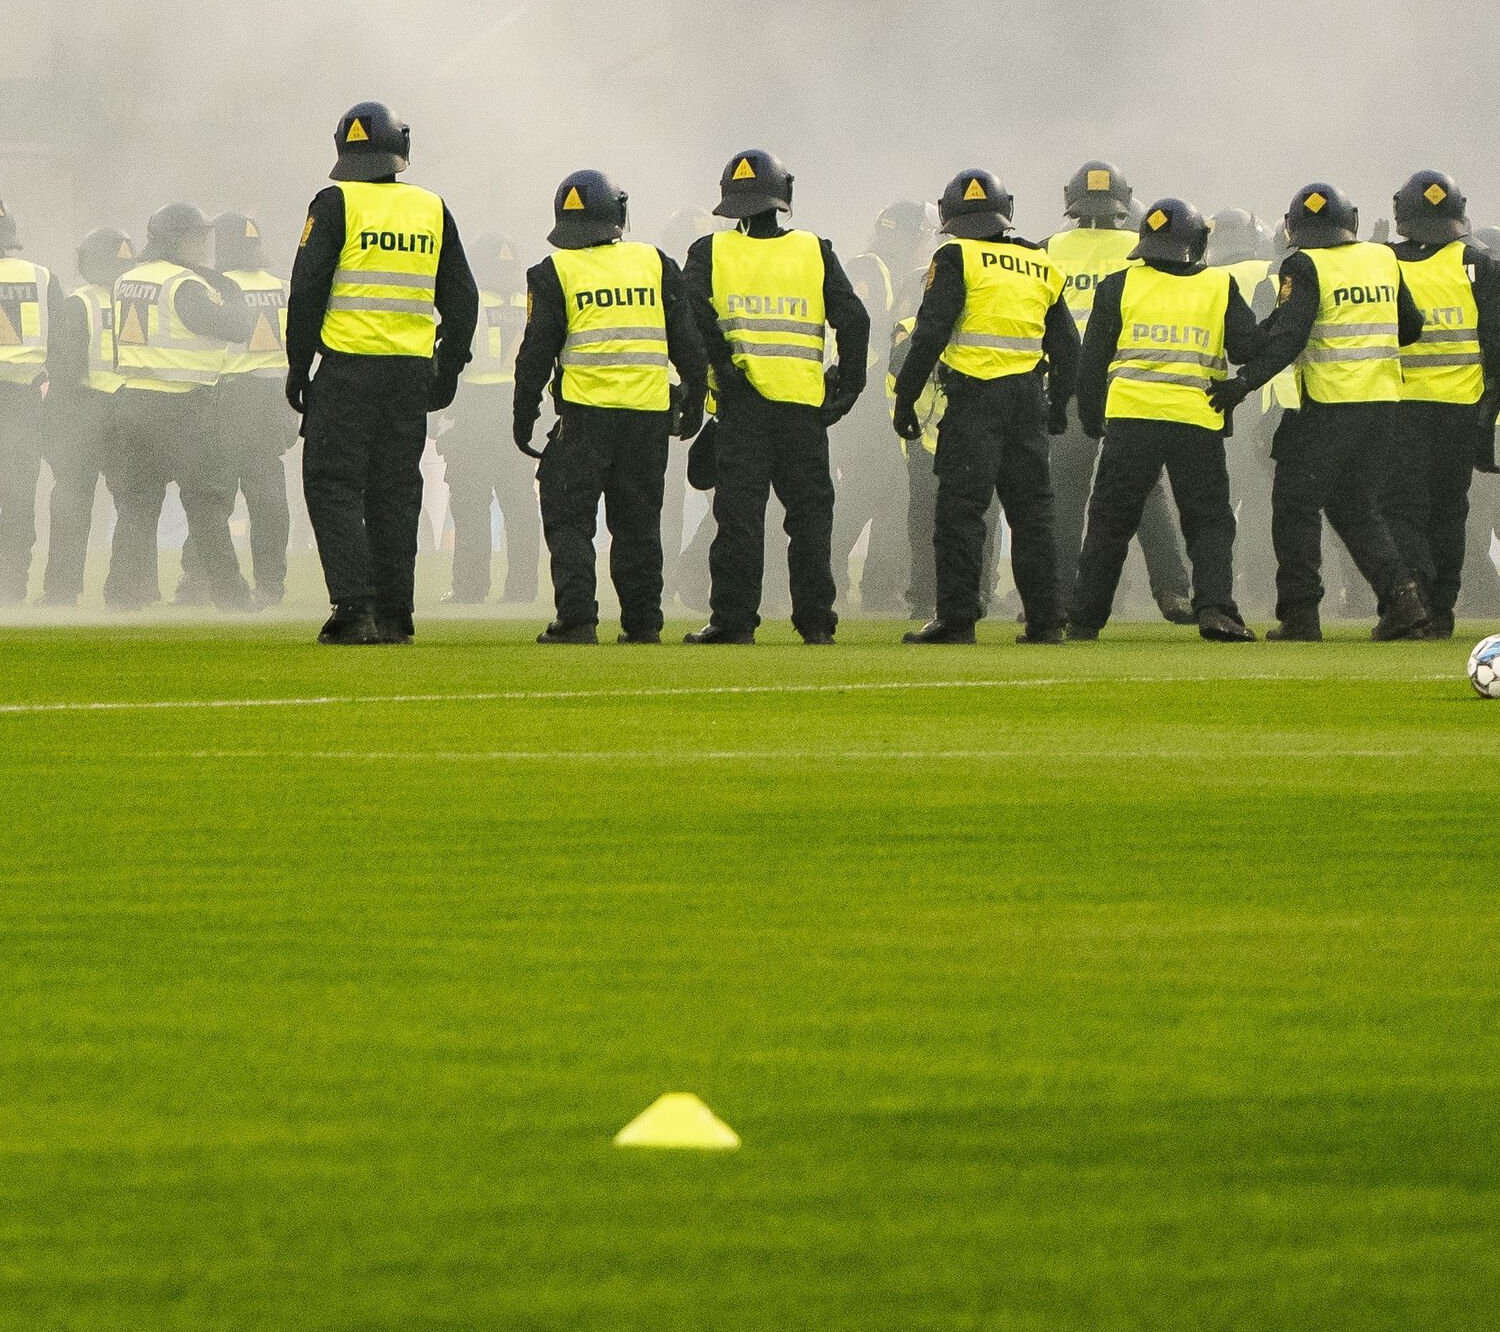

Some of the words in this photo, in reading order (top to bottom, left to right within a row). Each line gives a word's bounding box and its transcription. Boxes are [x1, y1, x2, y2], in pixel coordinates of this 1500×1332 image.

[358, 229, 436, 255] POLITI
[979, 250, 1052, 283] POLITI
[245, 291, 283, 308] OLITI
[574, 285, 657, 311] POLITI
[727, 294, 809, 318] POLITI
[1333, 283, 1396, 306] POLITI
[1131, 321, 1211, 349] POLITI
